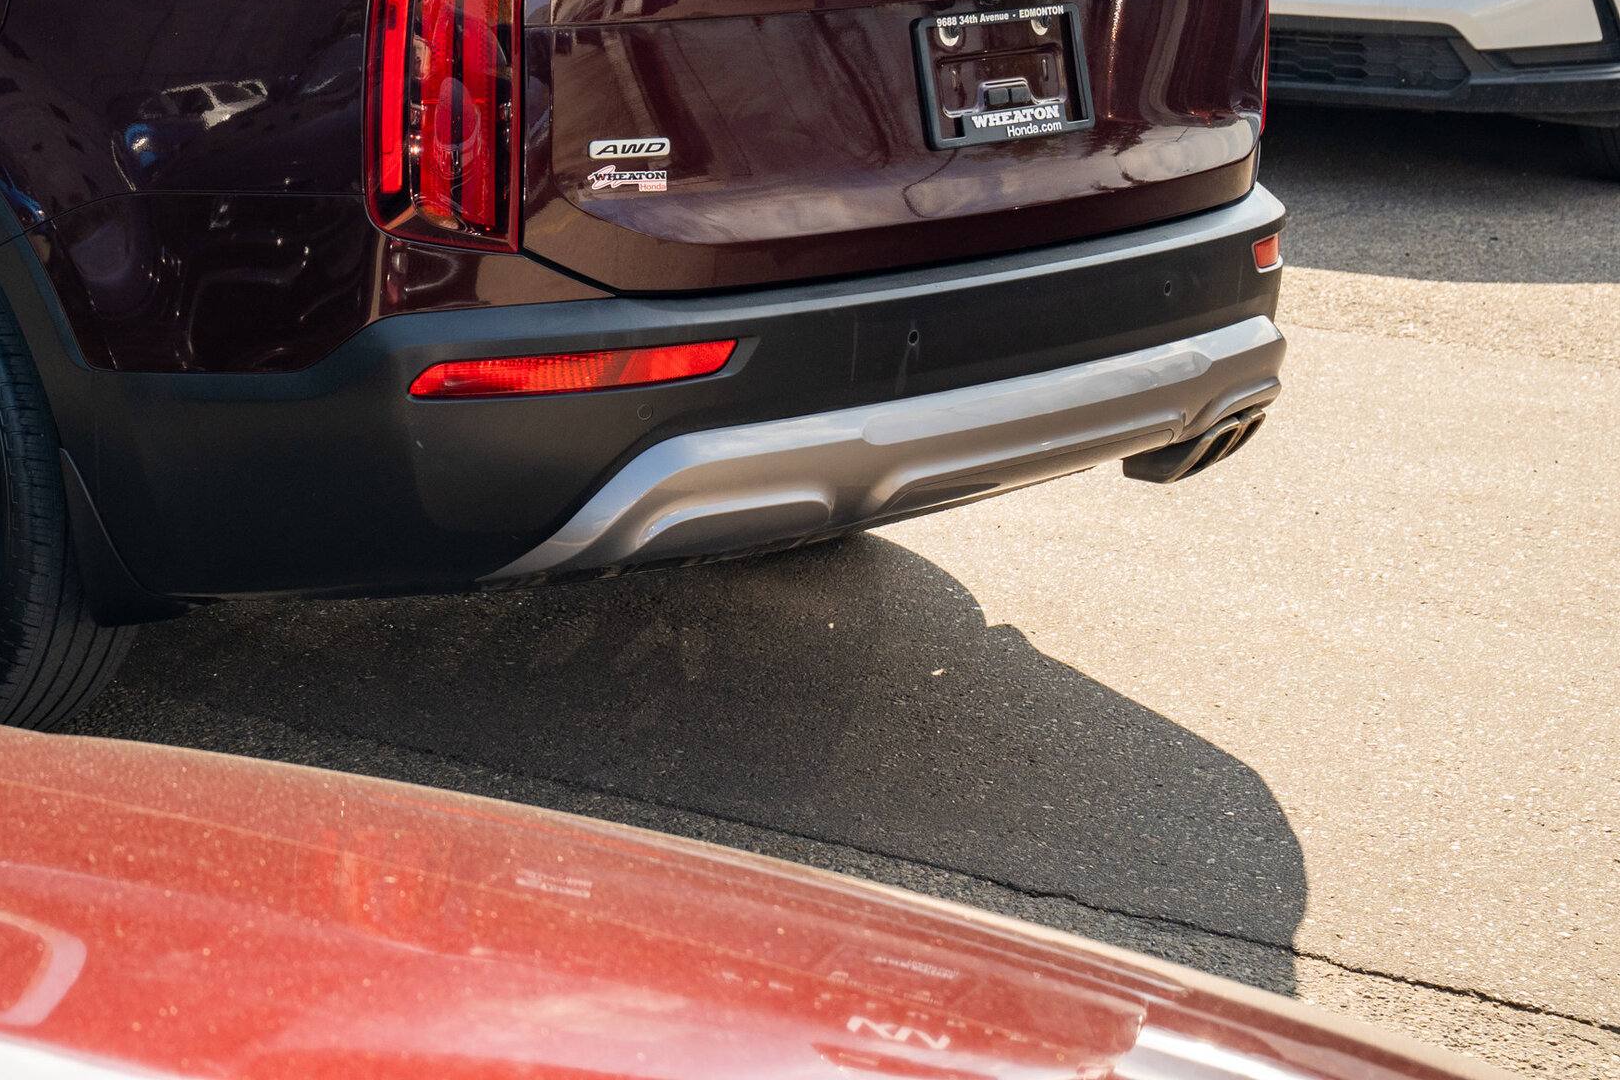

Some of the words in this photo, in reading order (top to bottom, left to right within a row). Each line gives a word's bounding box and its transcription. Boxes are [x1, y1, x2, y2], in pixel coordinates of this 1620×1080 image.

[937, 17, 957, 27] 9688
[959, 14, 978, 25] 34th
[980, 12, 1009, 22] Avenue
[1019, 5, 1064, 18] EDMONTON
[972, 105, 1060, 128] WHEATON
[1007, 122, 1062, 137] Honda.com
[596, 143, 666, 155] AWD
[593, 172, 666, 181] WHEATON
